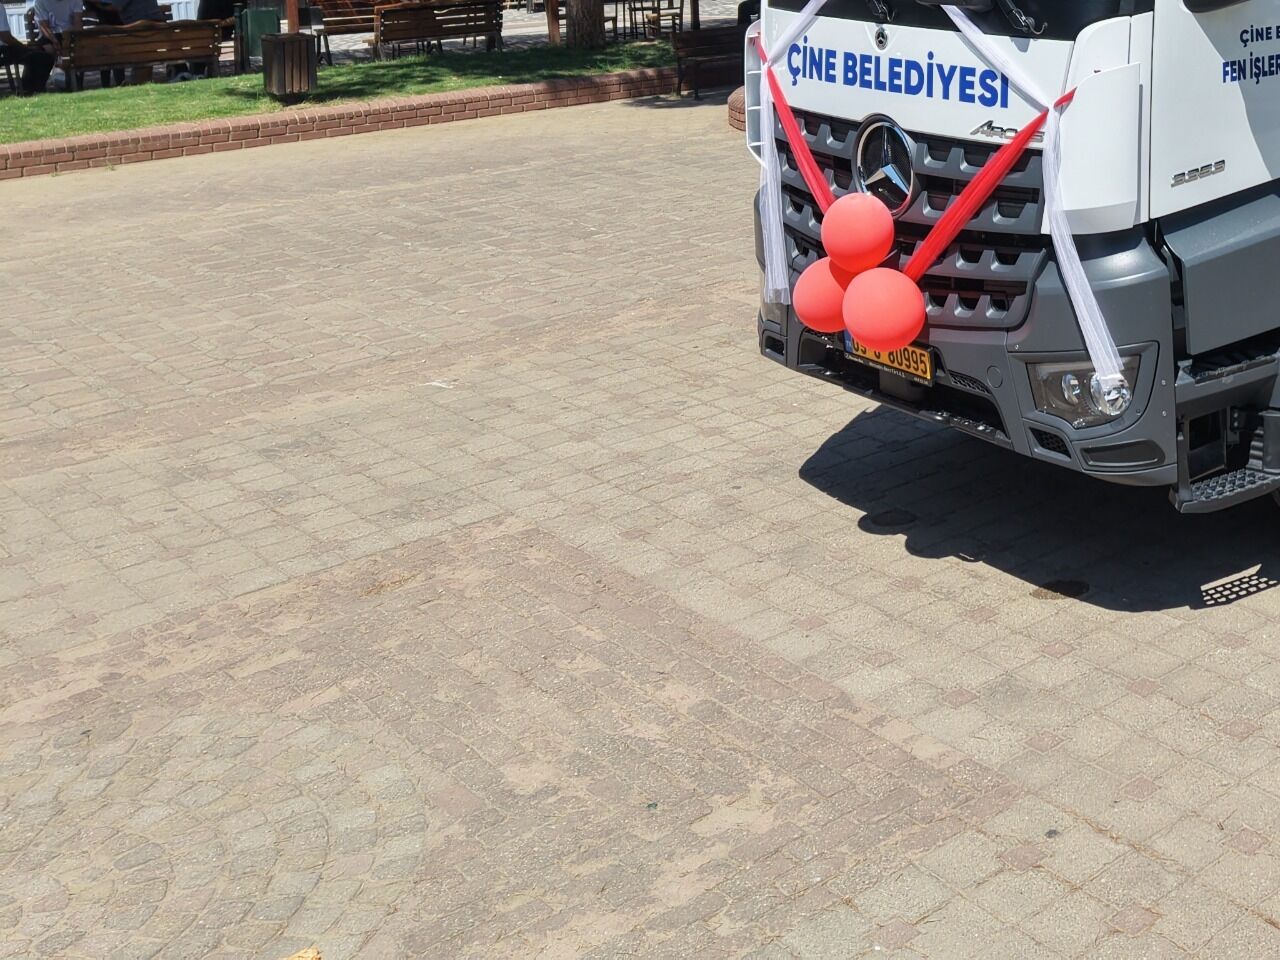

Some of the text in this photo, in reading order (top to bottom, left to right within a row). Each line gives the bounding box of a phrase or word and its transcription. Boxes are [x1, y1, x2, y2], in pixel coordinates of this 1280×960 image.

[1240, 24, 1273, 48] ÇİNE
[787, 35, 837, 87] ÇİNE
[1222, 58, 1247, 83] FEN
